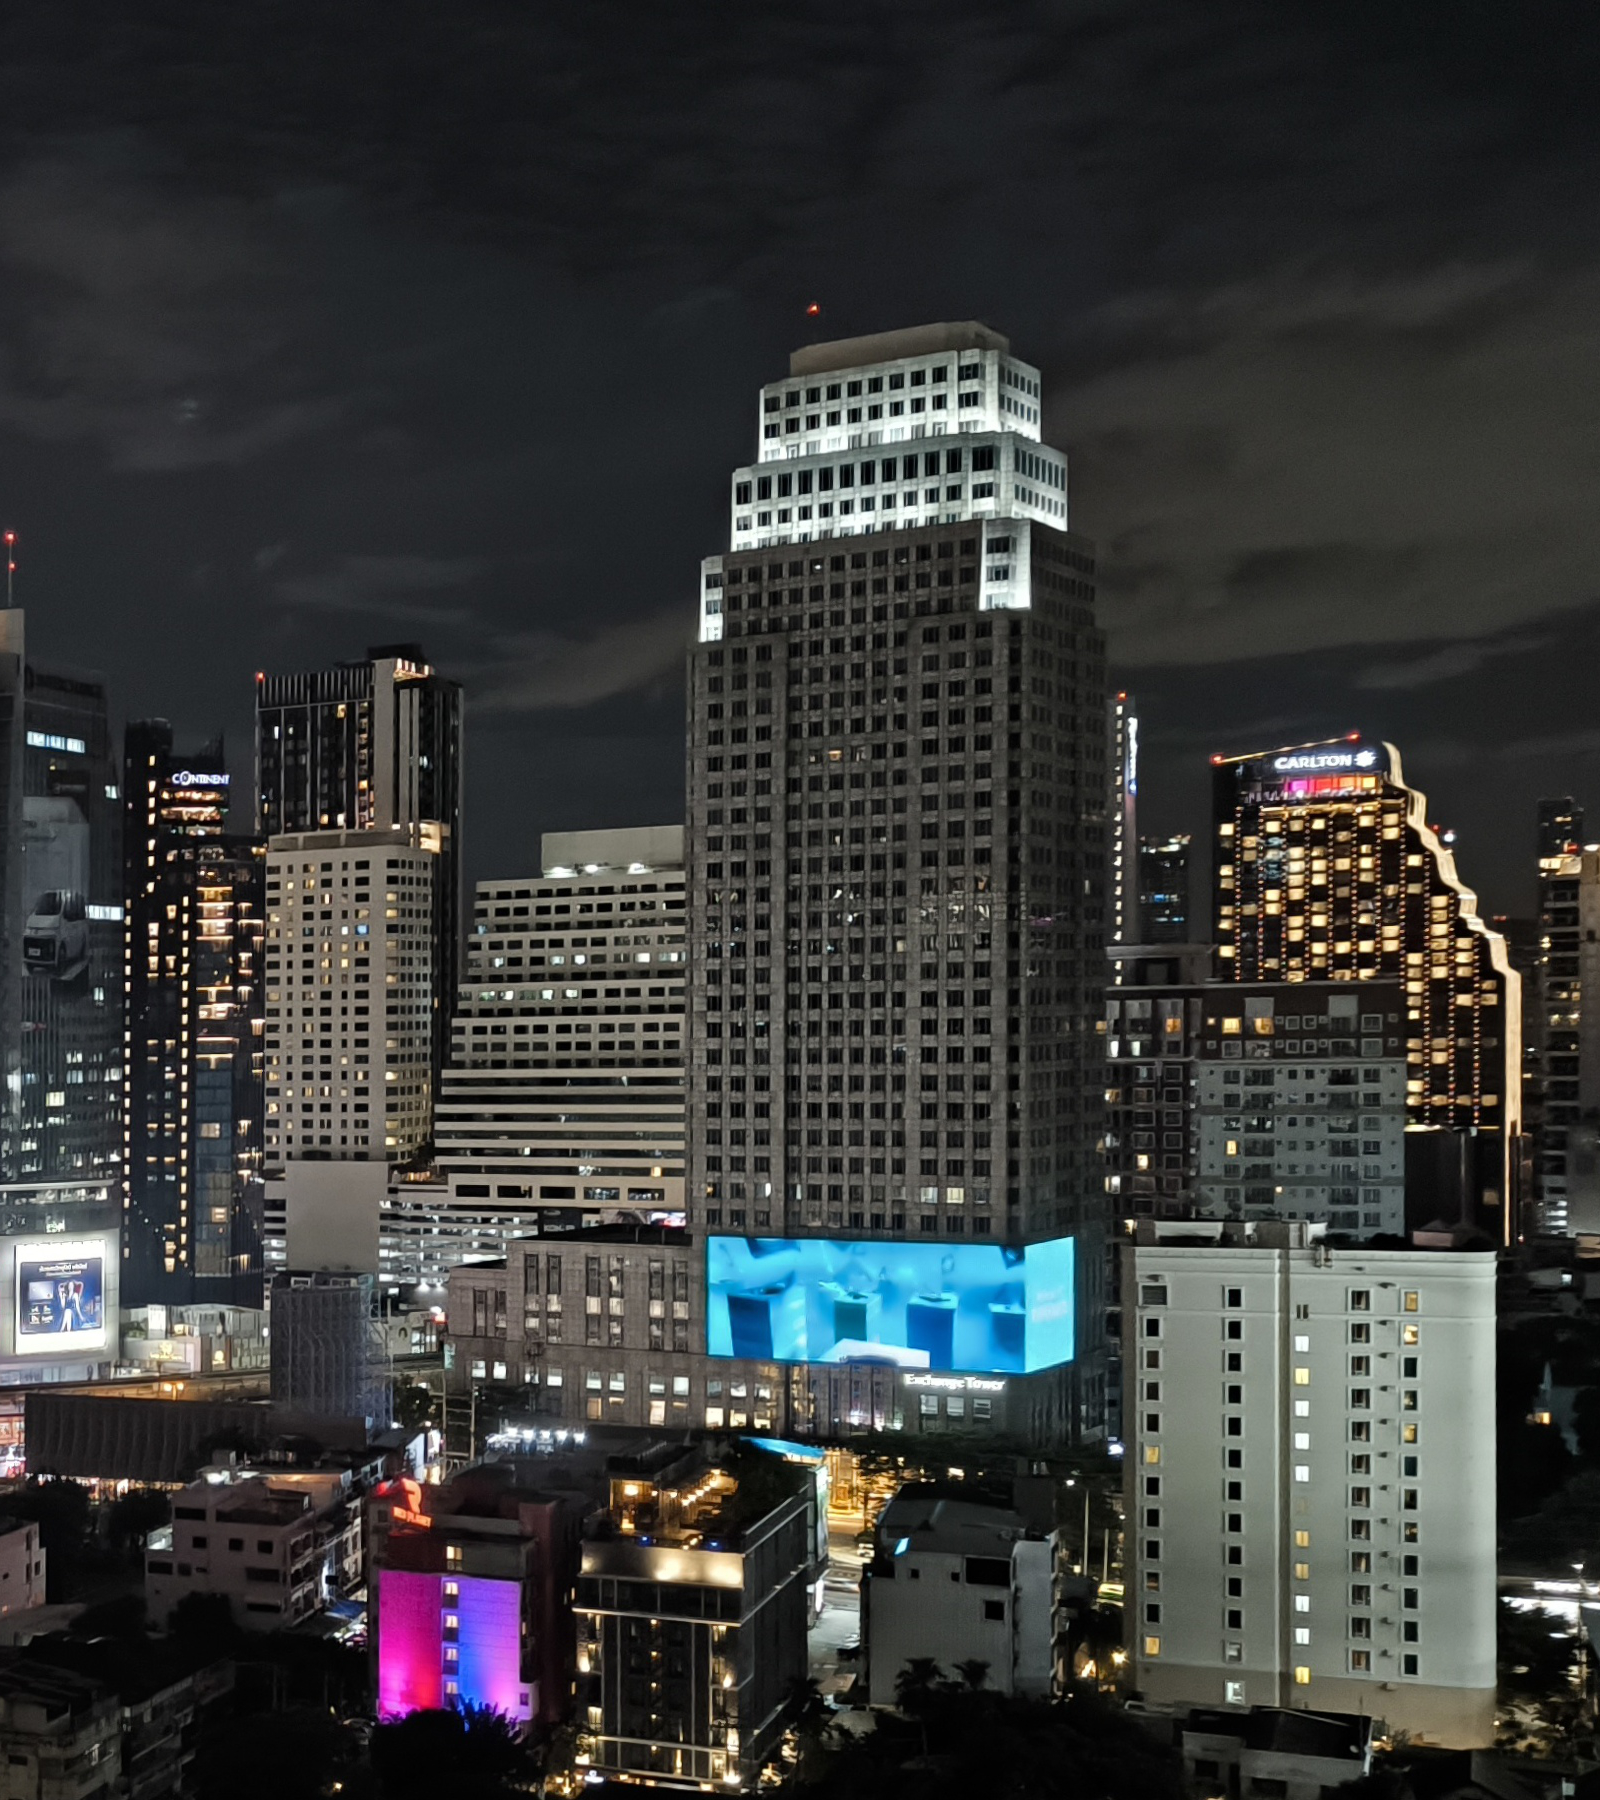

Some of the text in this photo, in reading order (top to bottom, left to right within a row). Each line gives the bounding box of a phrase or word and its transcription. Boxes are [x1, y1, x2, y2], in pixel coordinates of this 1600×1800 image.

[1274, 754, 1352, 770] CARLTON
[171, 770, 230, 786] CONTINENT
[903, 1373, 1006, 1392] Exchange Tower
